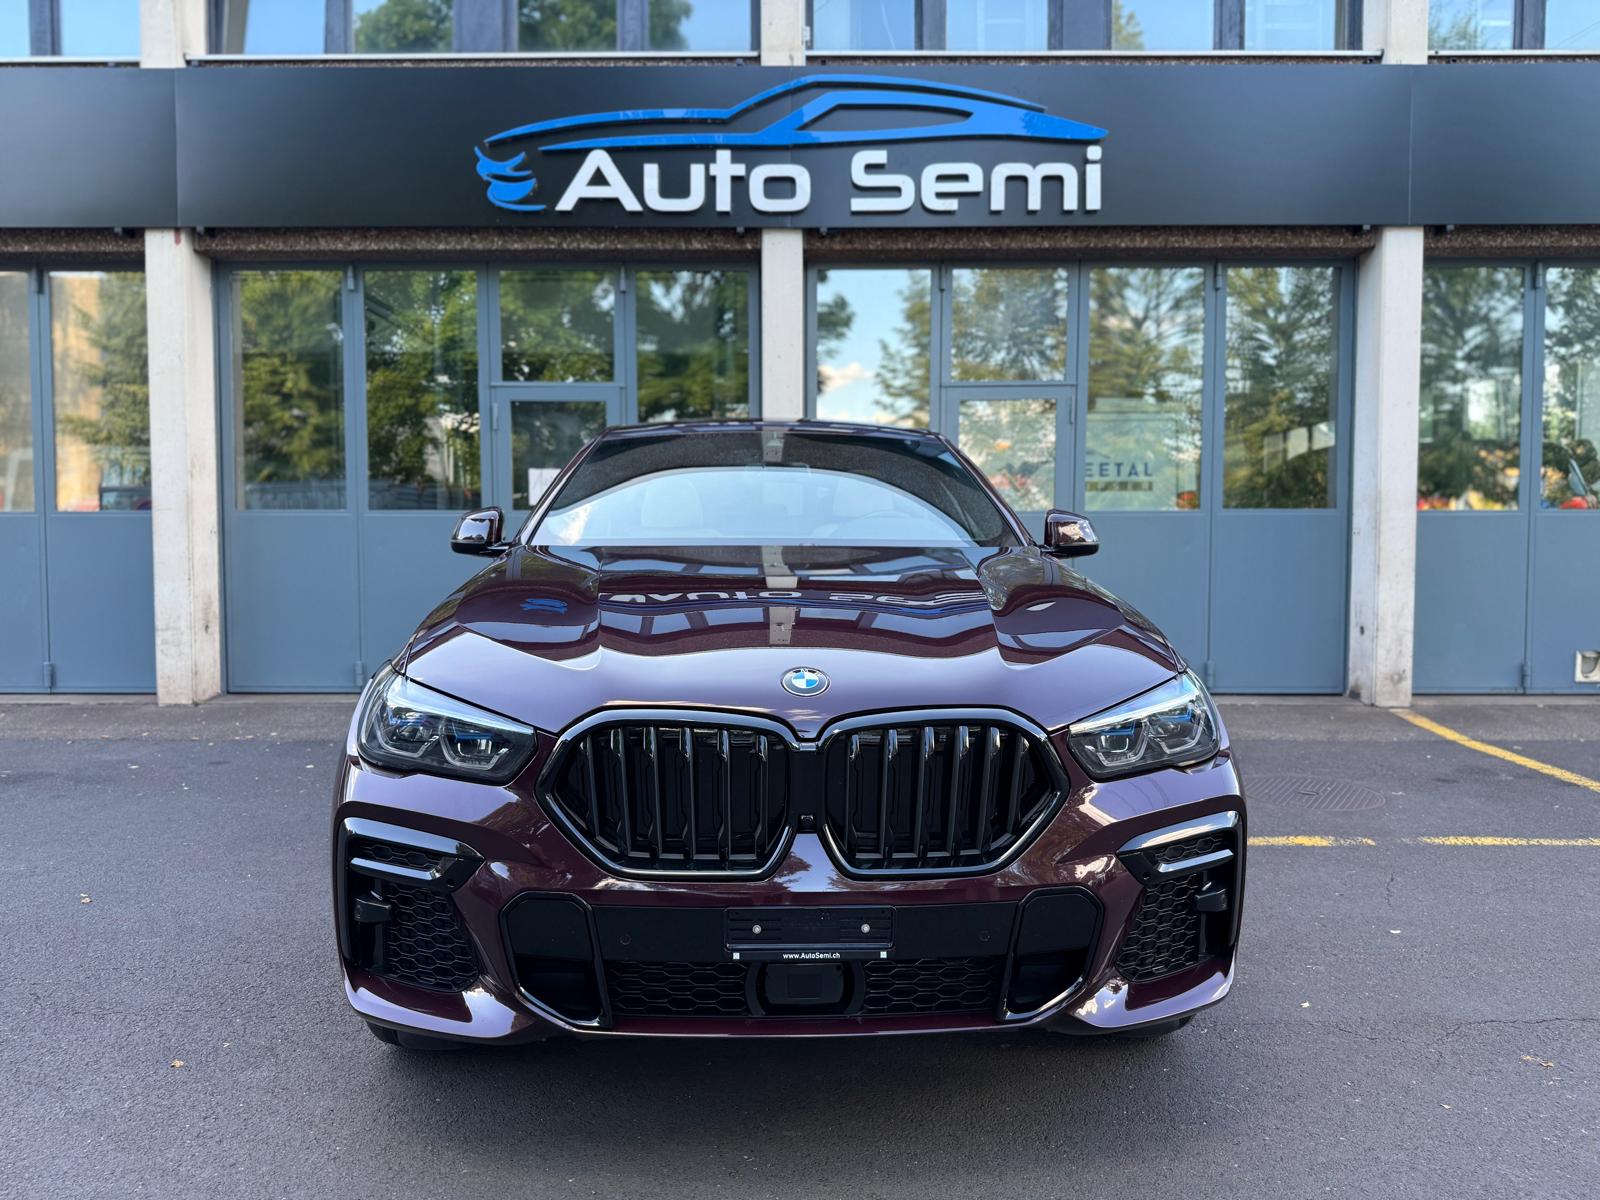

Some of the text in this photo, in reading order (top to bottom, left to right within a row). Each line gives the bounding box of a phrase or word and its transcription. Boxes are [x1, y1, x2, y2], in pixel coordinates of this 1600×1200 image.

[555, 145, 1103, 213] Auto Semi
[782, 951, 841, 959] www.AutoSemi.ch
